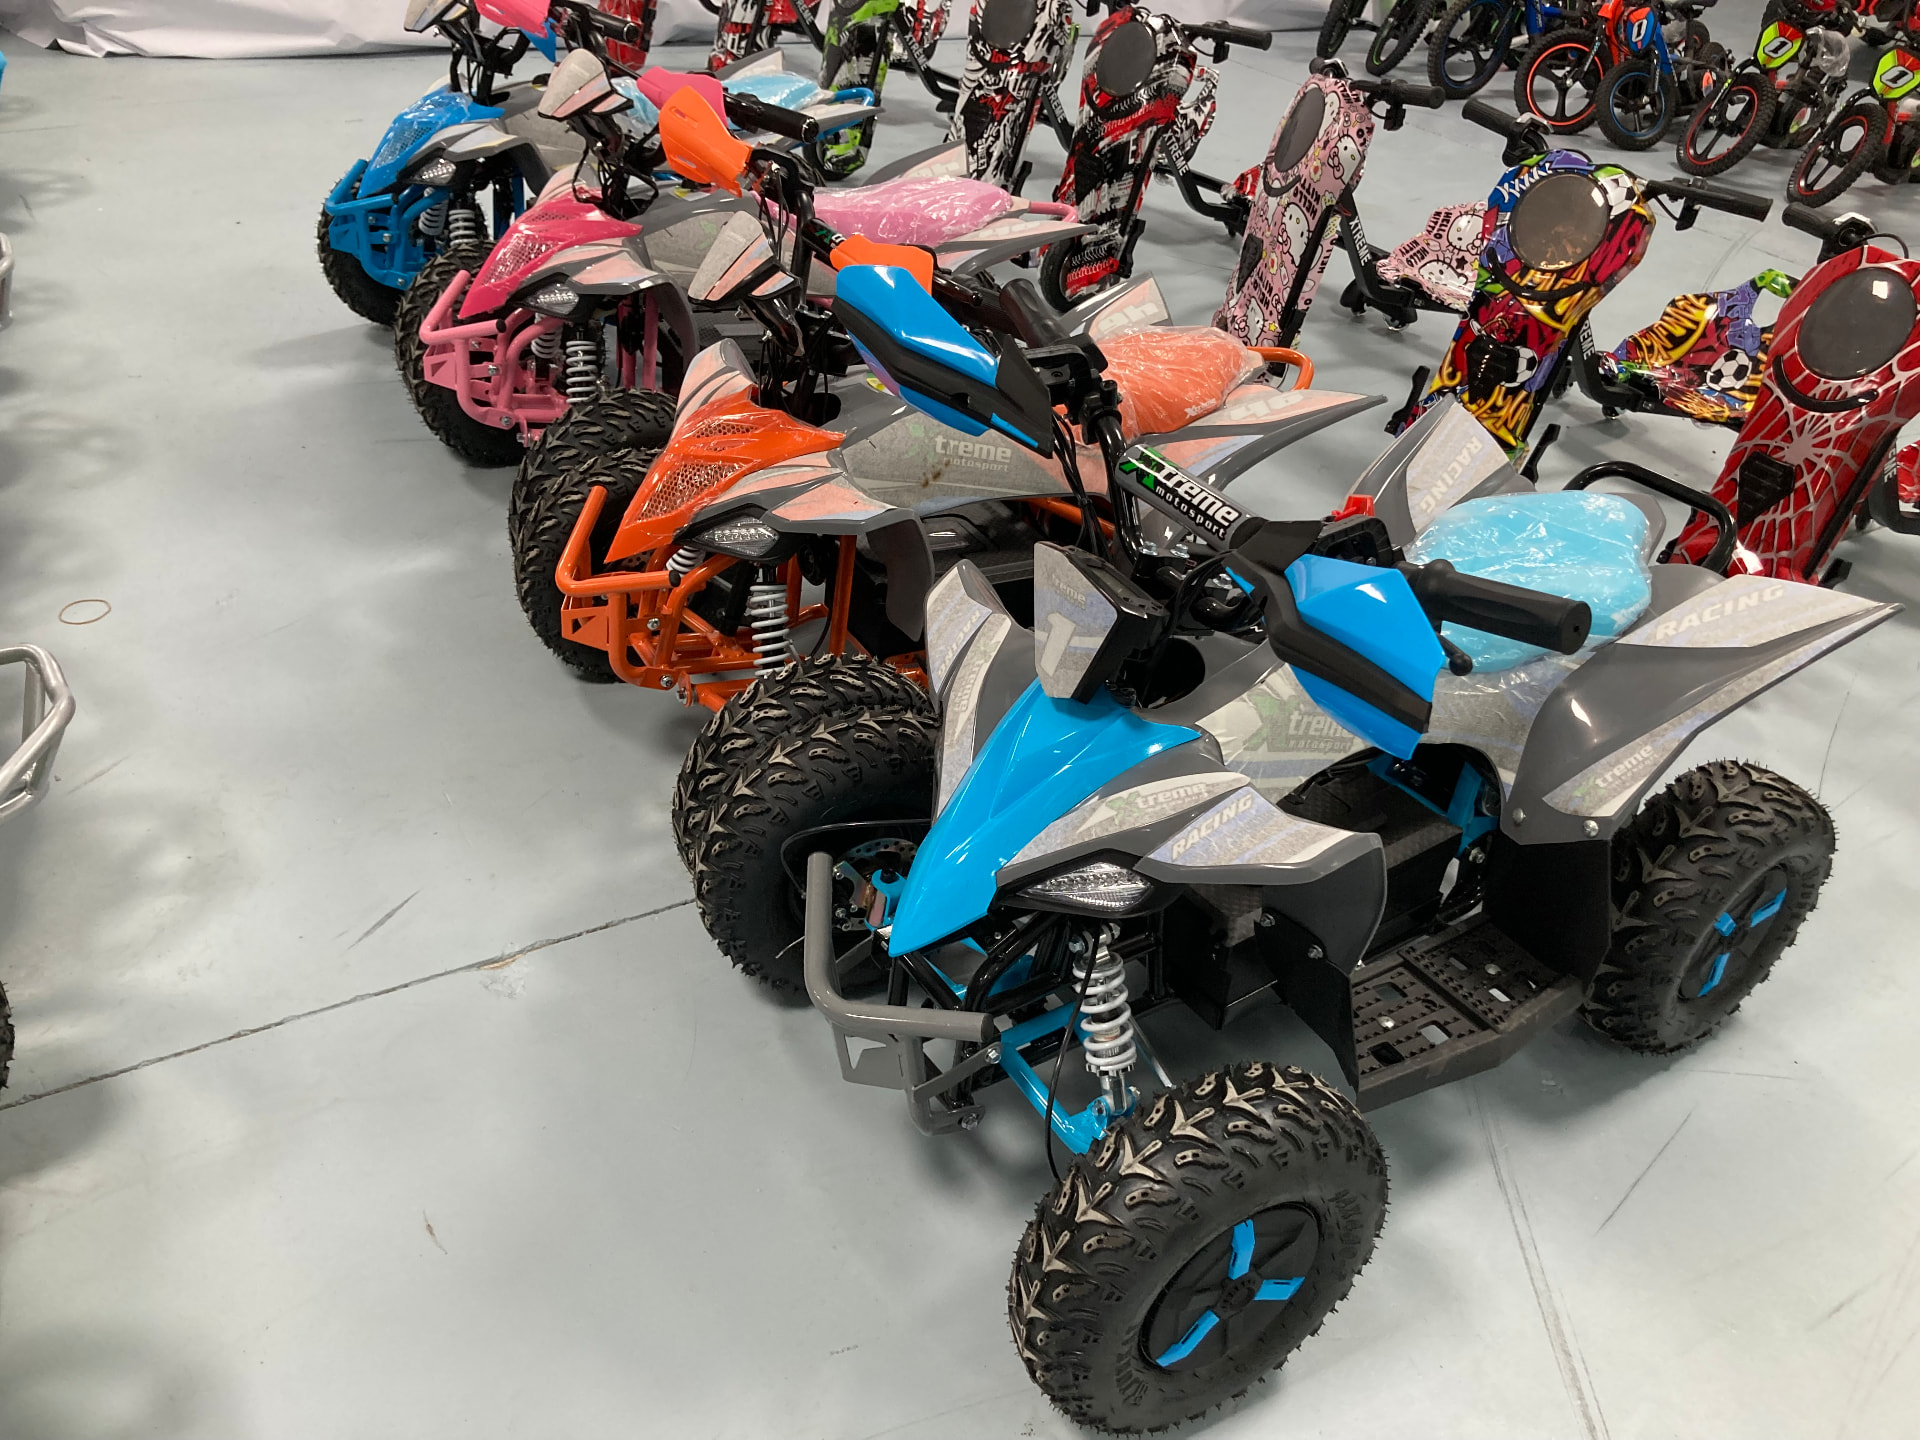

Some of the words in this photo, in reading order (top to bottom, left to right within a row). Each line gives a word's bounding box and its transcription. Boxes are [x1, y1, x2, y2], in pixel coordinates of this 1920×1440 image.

[797, 0, 815, 26] REME
[904, 33, 928, 72] XTREME
[1768, 41, 1789, 55] 1
[1886, 70, 1909, 85] 1
[1043, 80, 1066, 124] XTREME
[1163, 130, 1189, 177] XTREME
[1292, 185, 1318, 221] HELLO
[1425, 210, 1443, 236] KITTY
[1349, 215, 1372, 267] XTREME
[1433, 211, 1453, 240] HELLO
[1398, 239, 1421, 258] KITTY
[1405, 246, 1430, 268] HELLO
[1119, 447, 1240, 527] Xtreme
[1420, 436, 1484, 514] RACING
[1155, 485, 1226, 539] motosport
[1654, 584, 1785, 641] RACING
[1041, 612, 1076, 677] 1
[1171, 792, 1254, 863] RACING
